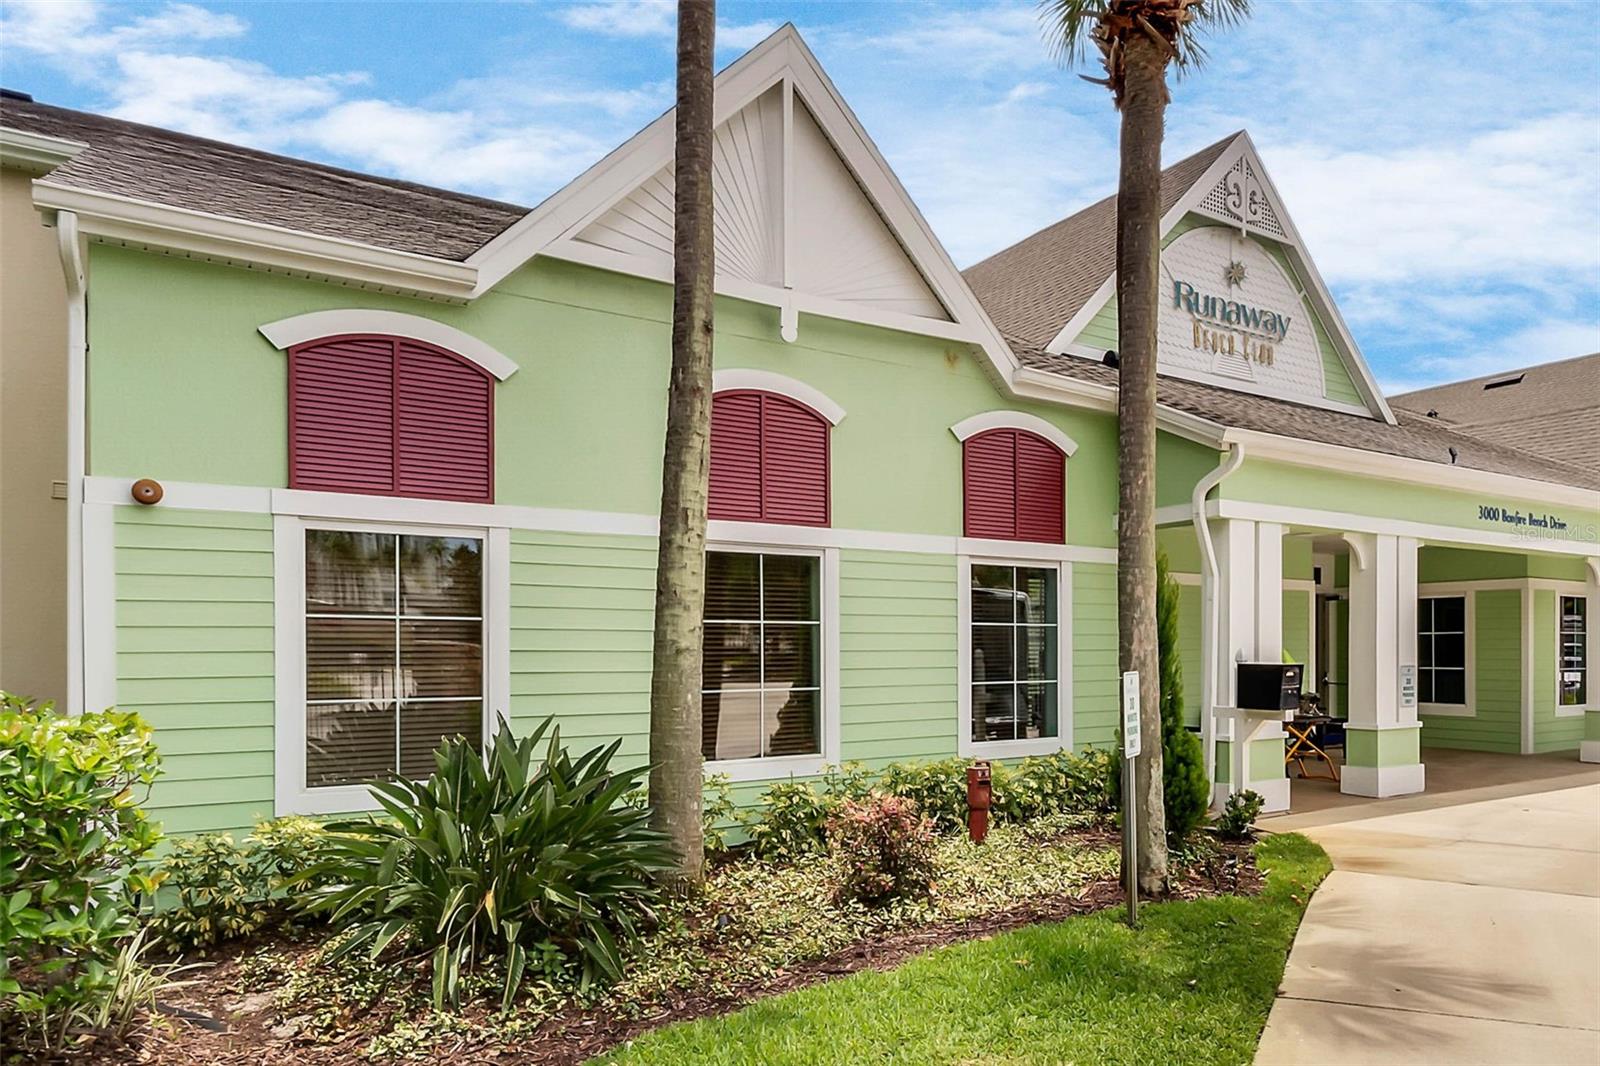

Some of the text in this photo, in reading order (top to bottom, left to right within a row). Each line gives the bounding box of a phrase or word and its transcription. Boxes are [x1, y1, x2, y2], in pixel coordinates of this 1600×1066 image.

[1174, 280, 1291, 340] Runaway
[1478, 505, 1500, 521] 3000
[1501, 508, 1527, 526] Bonfire
[1549, 515, 1567, 530] Drive
